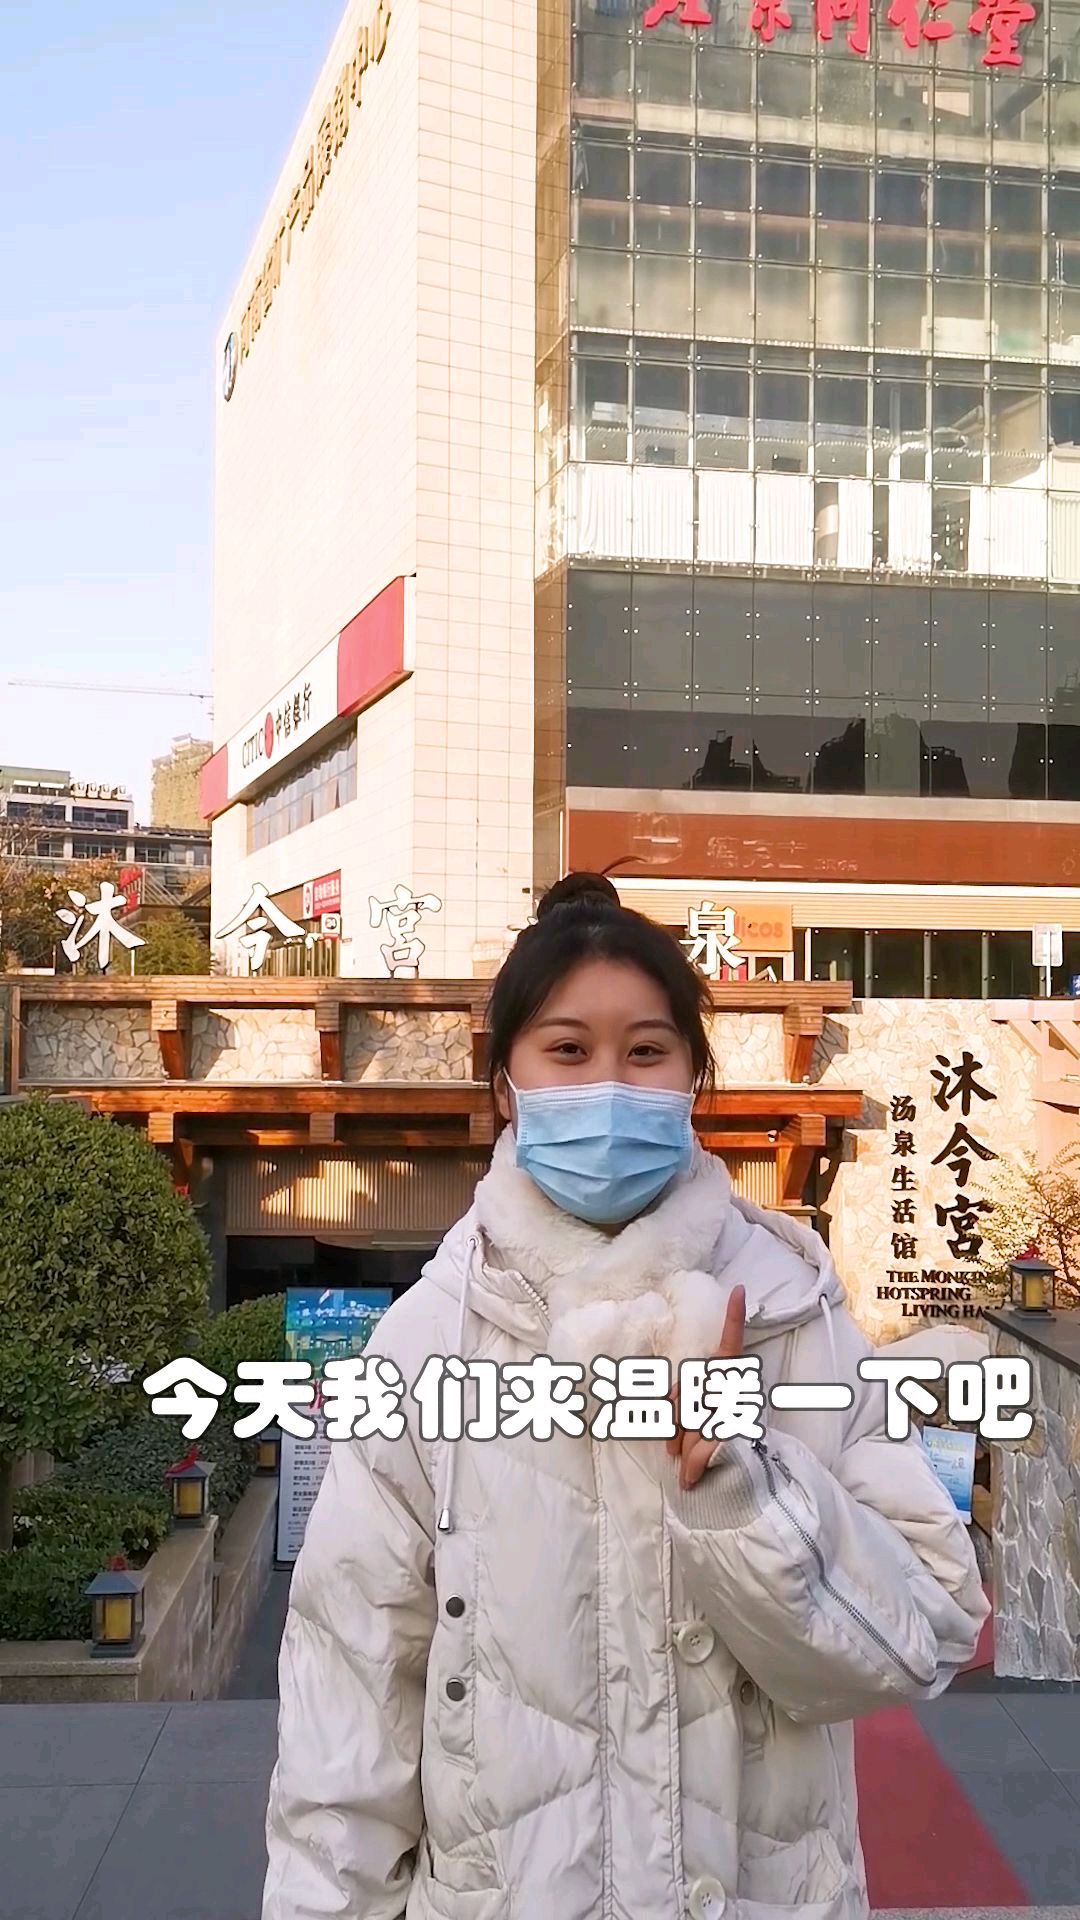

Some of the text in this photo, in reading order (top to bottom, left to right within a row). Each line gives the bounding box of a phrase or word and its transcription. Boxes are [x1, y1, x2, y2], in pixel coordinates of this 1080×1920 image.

[242, 727, 264, 769] CITIC
[889, 1095, 919, 1260] 汤泉生活馆
[885, 1270, 919, 1283] THE
[876, 1286, 971, 1301] HOTSPRING
[901, 1303, 959, 1318] LIVING
